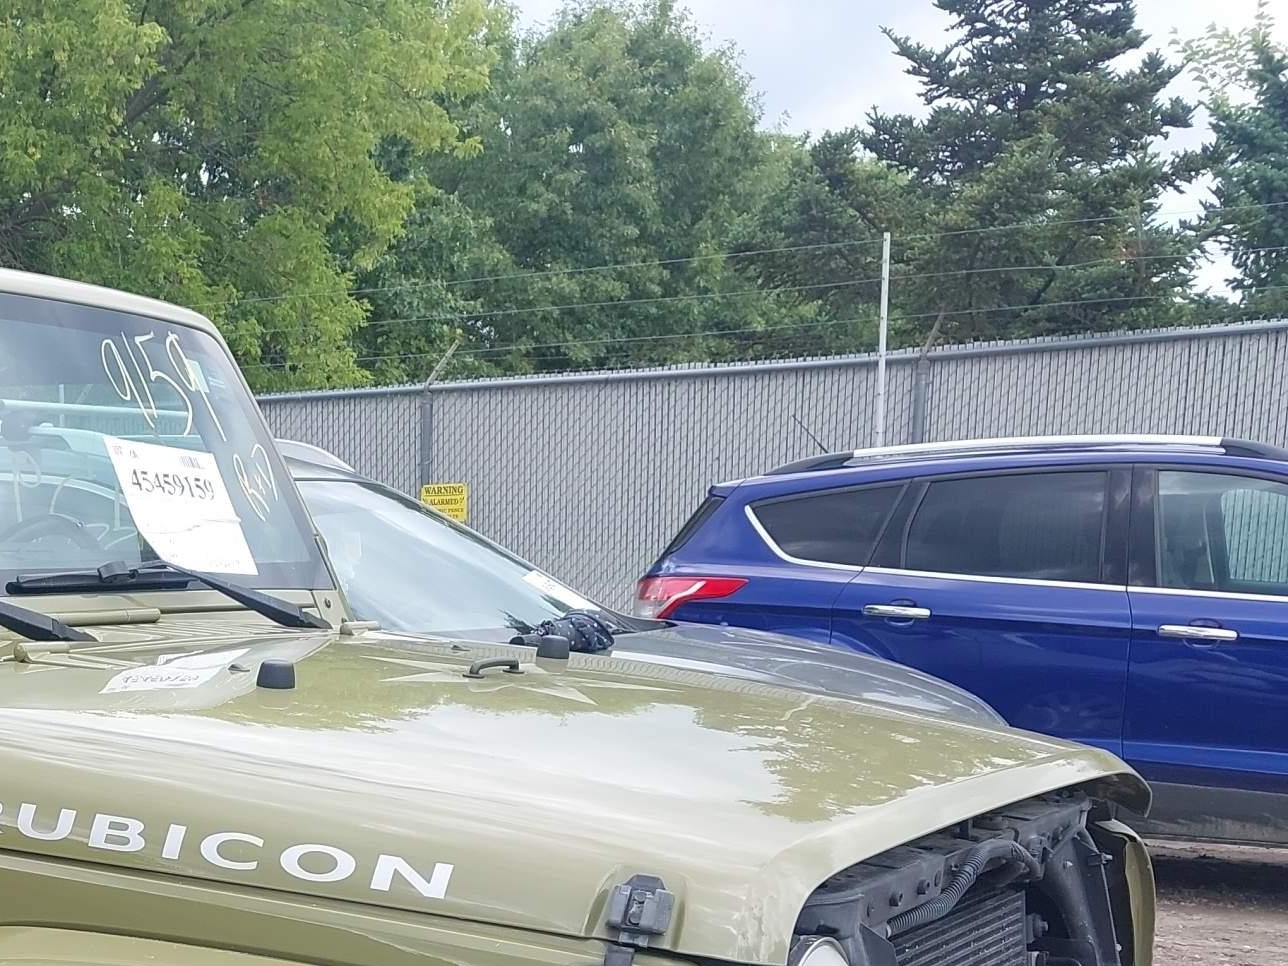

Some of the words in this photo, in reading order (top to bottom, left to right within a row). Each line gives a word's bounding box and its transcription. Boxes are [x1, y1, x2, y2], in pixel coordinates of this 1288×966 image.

[101, 331, 227, 442] 9159
[131, 468, 215, 500] 45459159
[424, 486, 463, 495] WARNING
